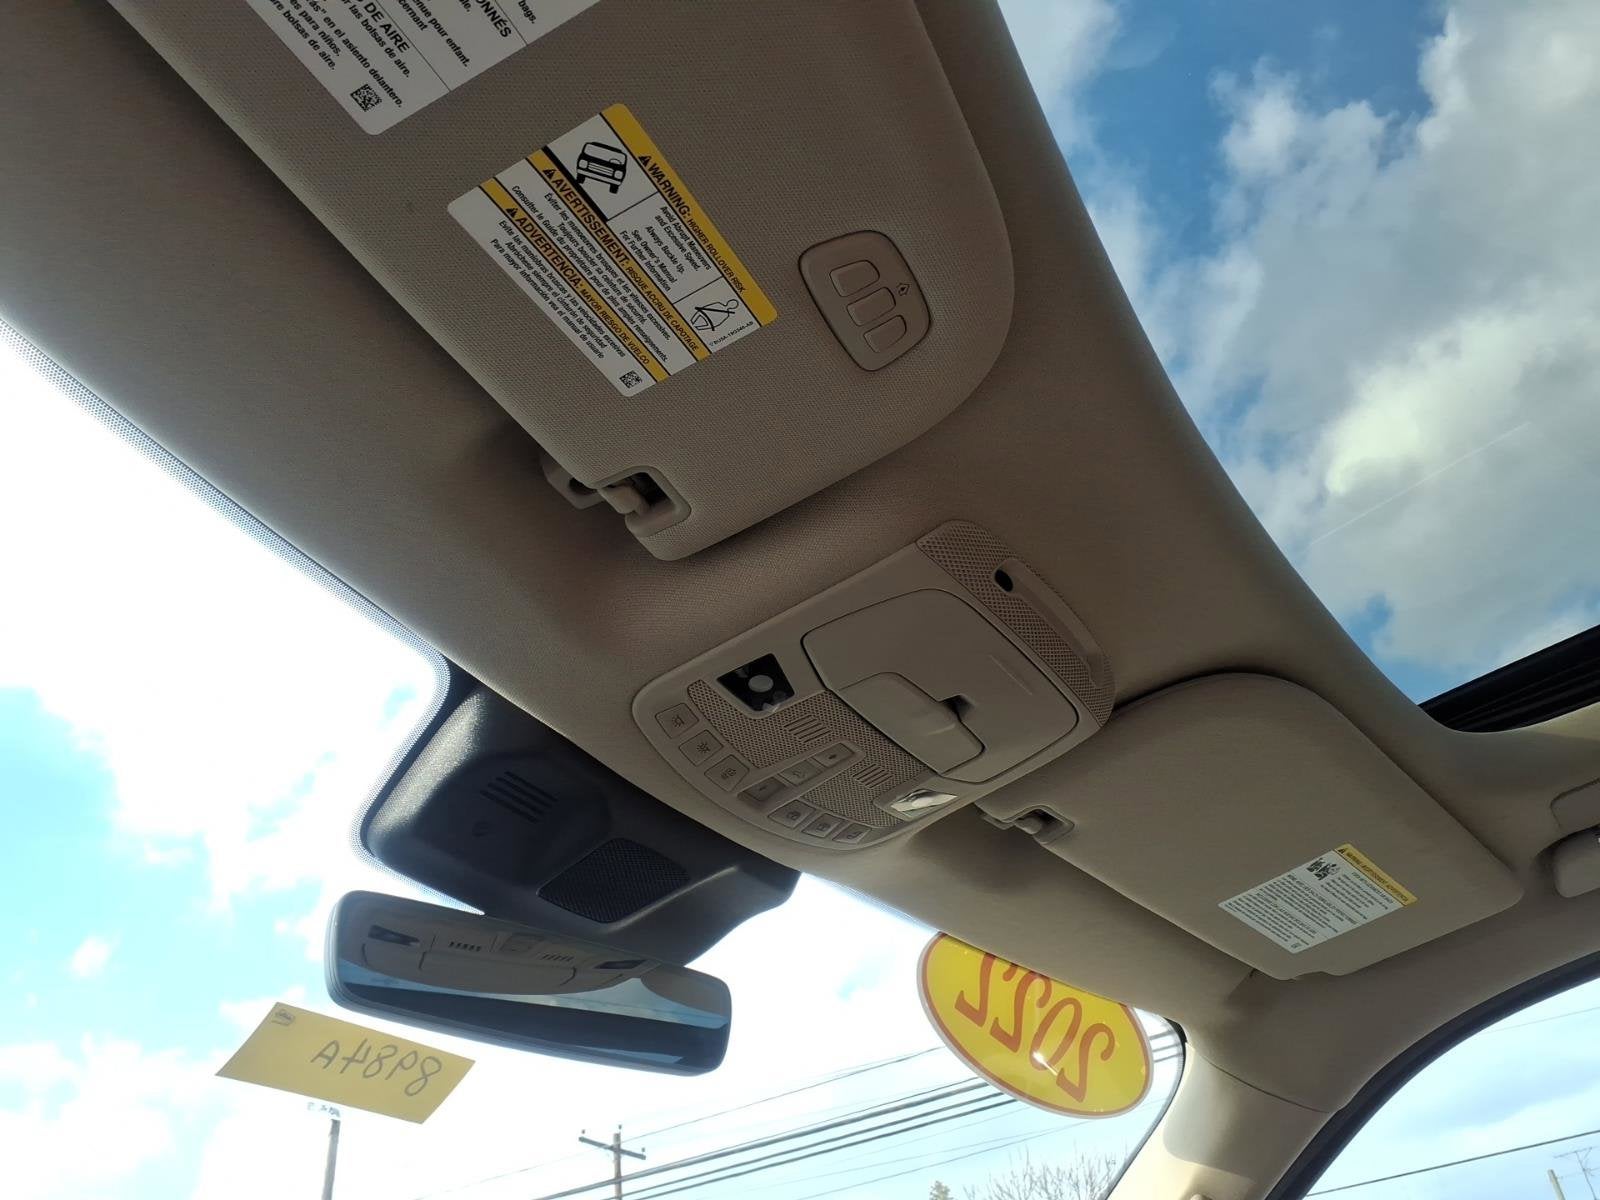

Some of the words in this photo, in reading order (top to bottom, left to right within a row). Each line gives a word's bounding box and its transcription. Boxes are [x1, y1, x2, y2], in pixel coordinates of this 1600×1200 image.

[282, 9, 310, 39] bolsas
[307, 39, 321, 51] de
[318, 50, 336, 71] aire.
[298, 10, 320, 31] para
[348, 4, 364, 20] las
[360, 18, 387, 48] bolsas
[384, 47, 397, 59] de
[393, 58, 410, 78] aire.
[363, 1, 385, 23] DE
[379, 23, 410, 53] AIRE
[427, 17, 449, 37] pour
[445, 37, 470, 67] enfant.
[517, 0, 537, 24] bags.
[323, 16, 336, 29] en
[333, 28, 346, 38] el
[341, 38, 371, 69] asiento
[368, 68, 403, 108] delantero.
[511, 185, 539, 214] Consulter
[535, 212, 545, 221] le
[541, 219, 559, 238] Guide
[556, 236, 567, 246] du
[588, 275, 605, 289] pour
[601, 287, 611, 296] de
[606, 295, 621, 308] plus
[631, 229, 643, 242] See
[640, 240, 661, 264] Owner's
[657, 262, 678, 284] Manual
[645, 225, 664, 247] Always
[660, 245, 679, 265] Buckle
[647, 162, 691, 219] WARNING:
[686, 218, 710, 245] HIGHER
[705, 243, 735, 279] ROLLOVER
[730, 276, 746, 294] RISK
[654, 214, 669, 227] and
[663, 225, 687, 254] Excessive
[683, 251, 702, 272] Speed.
[659, 206, 677, 223] Avoid
[671, 222, 691, 242] Abrupt
[686, 240, 712, 271] Maneuvers
[490, 238, 506, 254] Para
[502, 253, 522, 271] mayor
[561, 315, 583, 335] manual
[579, 333, 588, 342] de
[498, 219, 515, 236] Evite
[511, 234, 524, 246] las
[520, 244, 550, 274] maniobras
[546, 271, 568, 295] bruscas
[568, 296, 580, 308] las
[577, 305, 606, 335] velocidades
[514, 217, 584, 289] ADVERTENCIA:
[579, 288, 603, 312] MAYOR
[598, 310, 623, 334] RIESGO
[618, 331, 631, 343] DE
[627, 340, 650, 365] VUELCO
[551, 178, 631, 267] AVERTISSEMENT:
[625, 266, 649, 291] RISQUE
[644, 290, 667, 312] ACCRU
[662, 310, 674, 321] DE
[670, 319, 700, 352] CAPOTAGE
[556, 221, 580, 248] Toujours
[576, 245, 599, 268] boucler
[594, 267, 604, 275] sa
[601, 274, 623, 297] ceinture
[619, 295, 629, 304] de
[558, 210, 570, 222] les
[595, 252, 619, 279] brusques
[616, 277, 626, 286] et
[621, 283, 632, 294] les
[629, 292, 649, 314] vitesses
[619, 230, 631, 242] For
[627, 239, 648, 262] Further
[644, 260, 672, 292] Information
[531, 269, 554, 293] siempre
[575, 317, 585, 326] de
